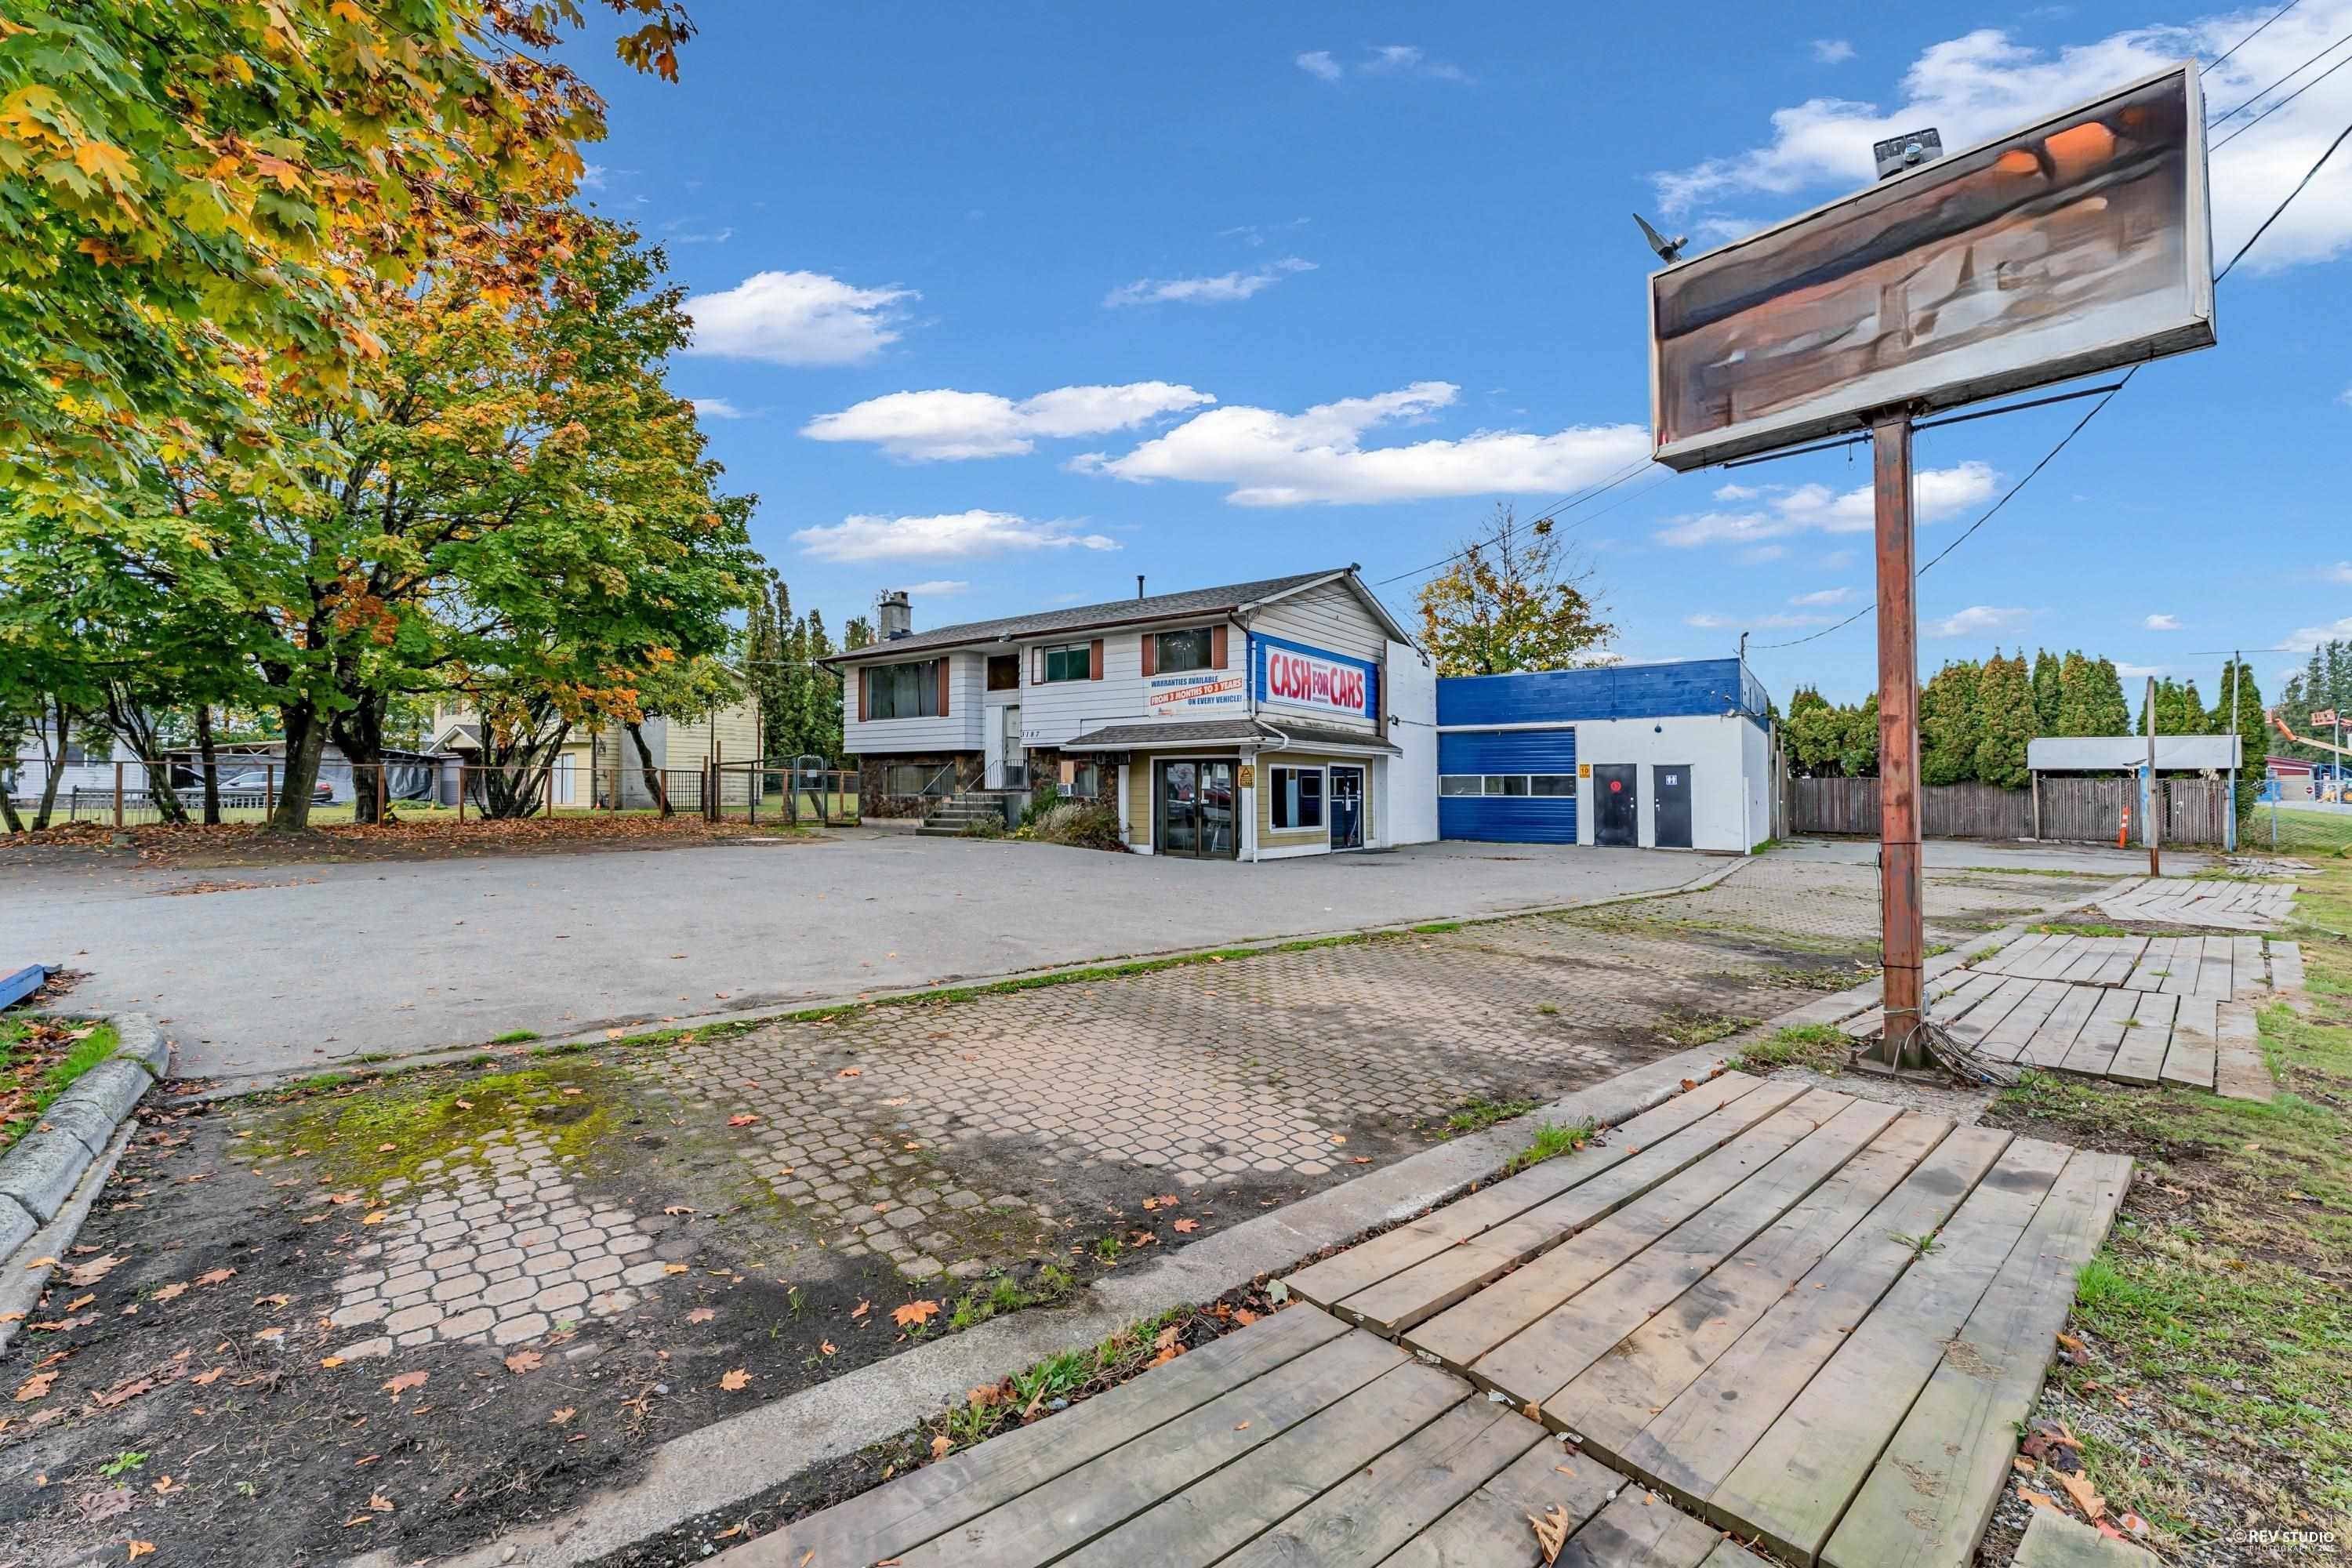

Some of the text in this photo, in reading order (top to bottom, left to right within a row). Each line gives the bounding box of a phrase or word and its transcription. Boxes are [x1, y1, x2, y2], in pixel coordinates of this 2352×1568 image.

[1151, 676, 1218, 688] WARRANTIES AVAILABLE
[1270, 653, 1363, 710] CASH FOR CARS
[1151, 695, 1169, 705] FROM
[1175, 688, 1203, 699] MONTHS
[1203, 684, 1214, 694] TO
[1220, 679, 1242, 691] YEARS
[1197, 696, 1214, 705] EVERY
[1215, 695, 1242, 703] VEHICLE!
